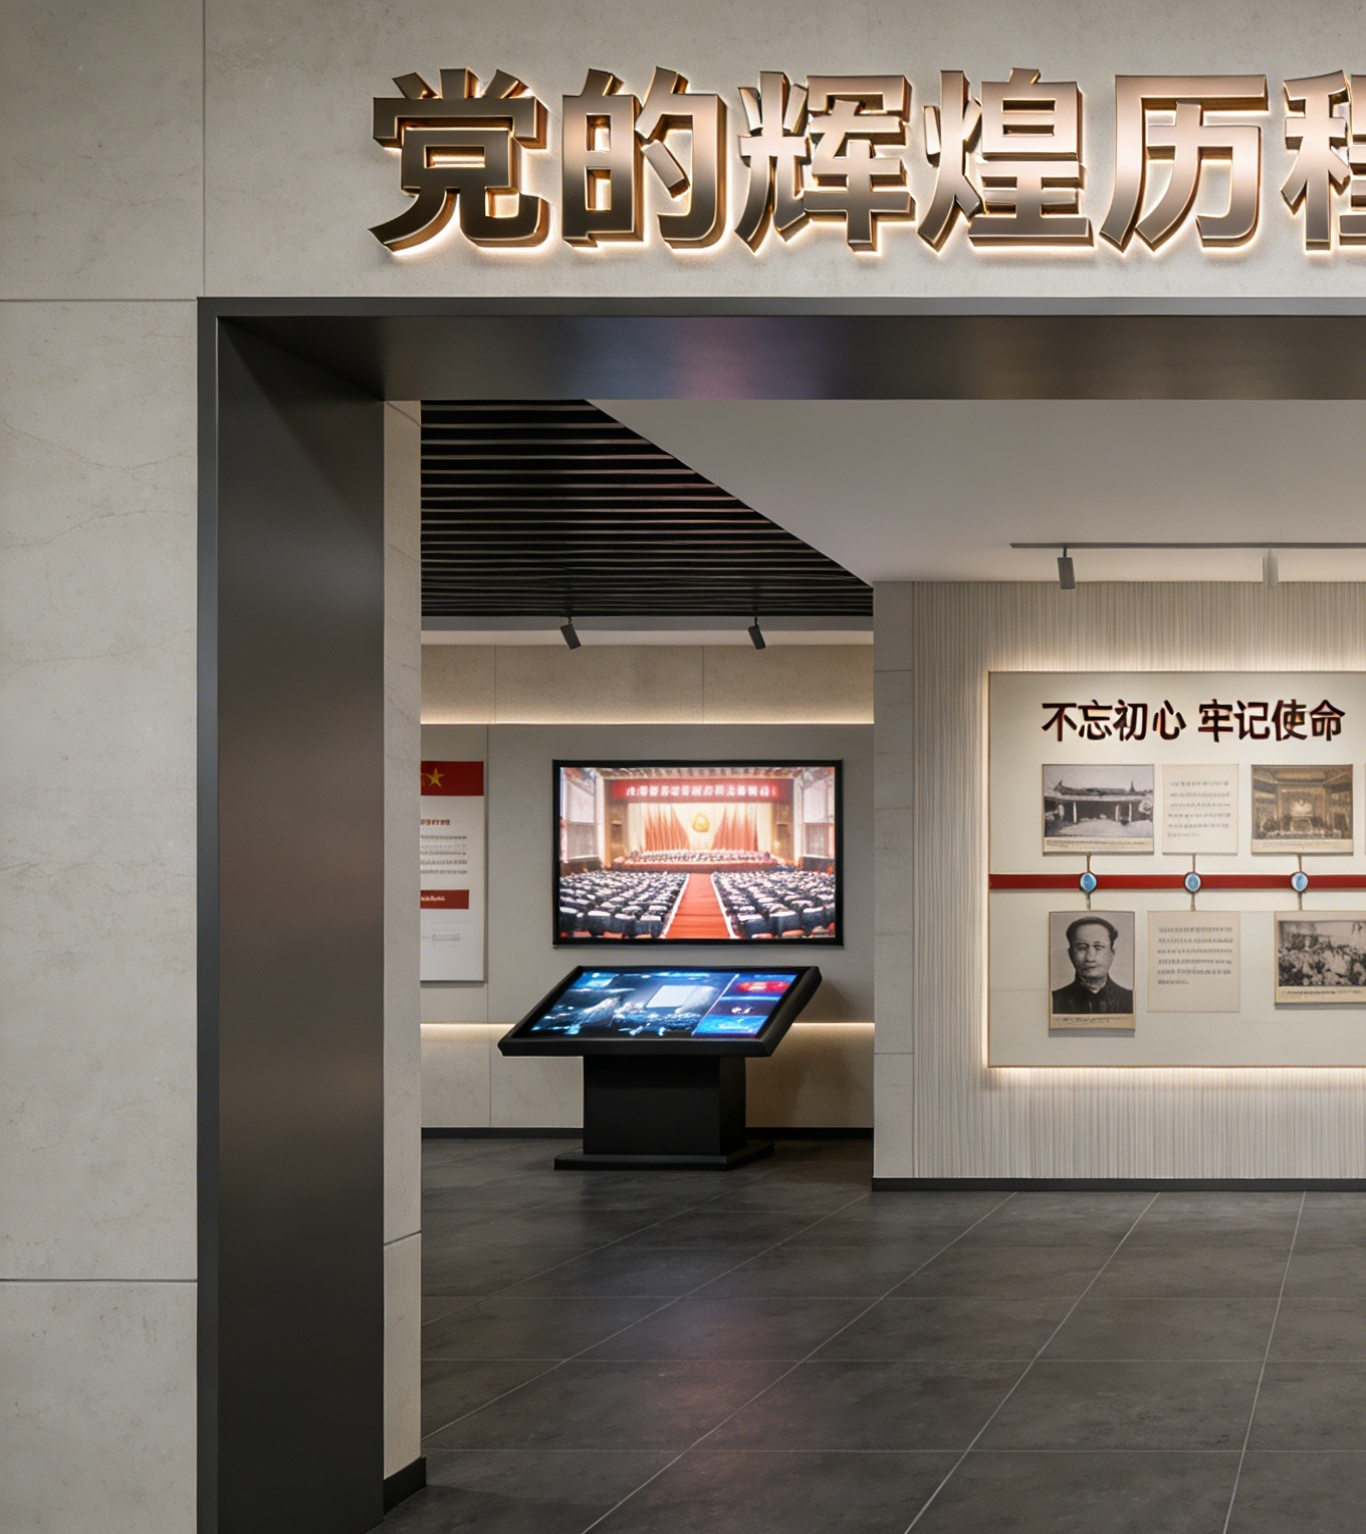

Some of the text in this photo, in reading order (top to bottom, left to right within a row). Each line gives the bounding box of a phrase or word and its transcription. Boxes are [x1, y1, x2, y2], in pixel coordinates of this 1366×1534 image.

[1041, 699, 1346, 742] 不忘初心 牢记使命
